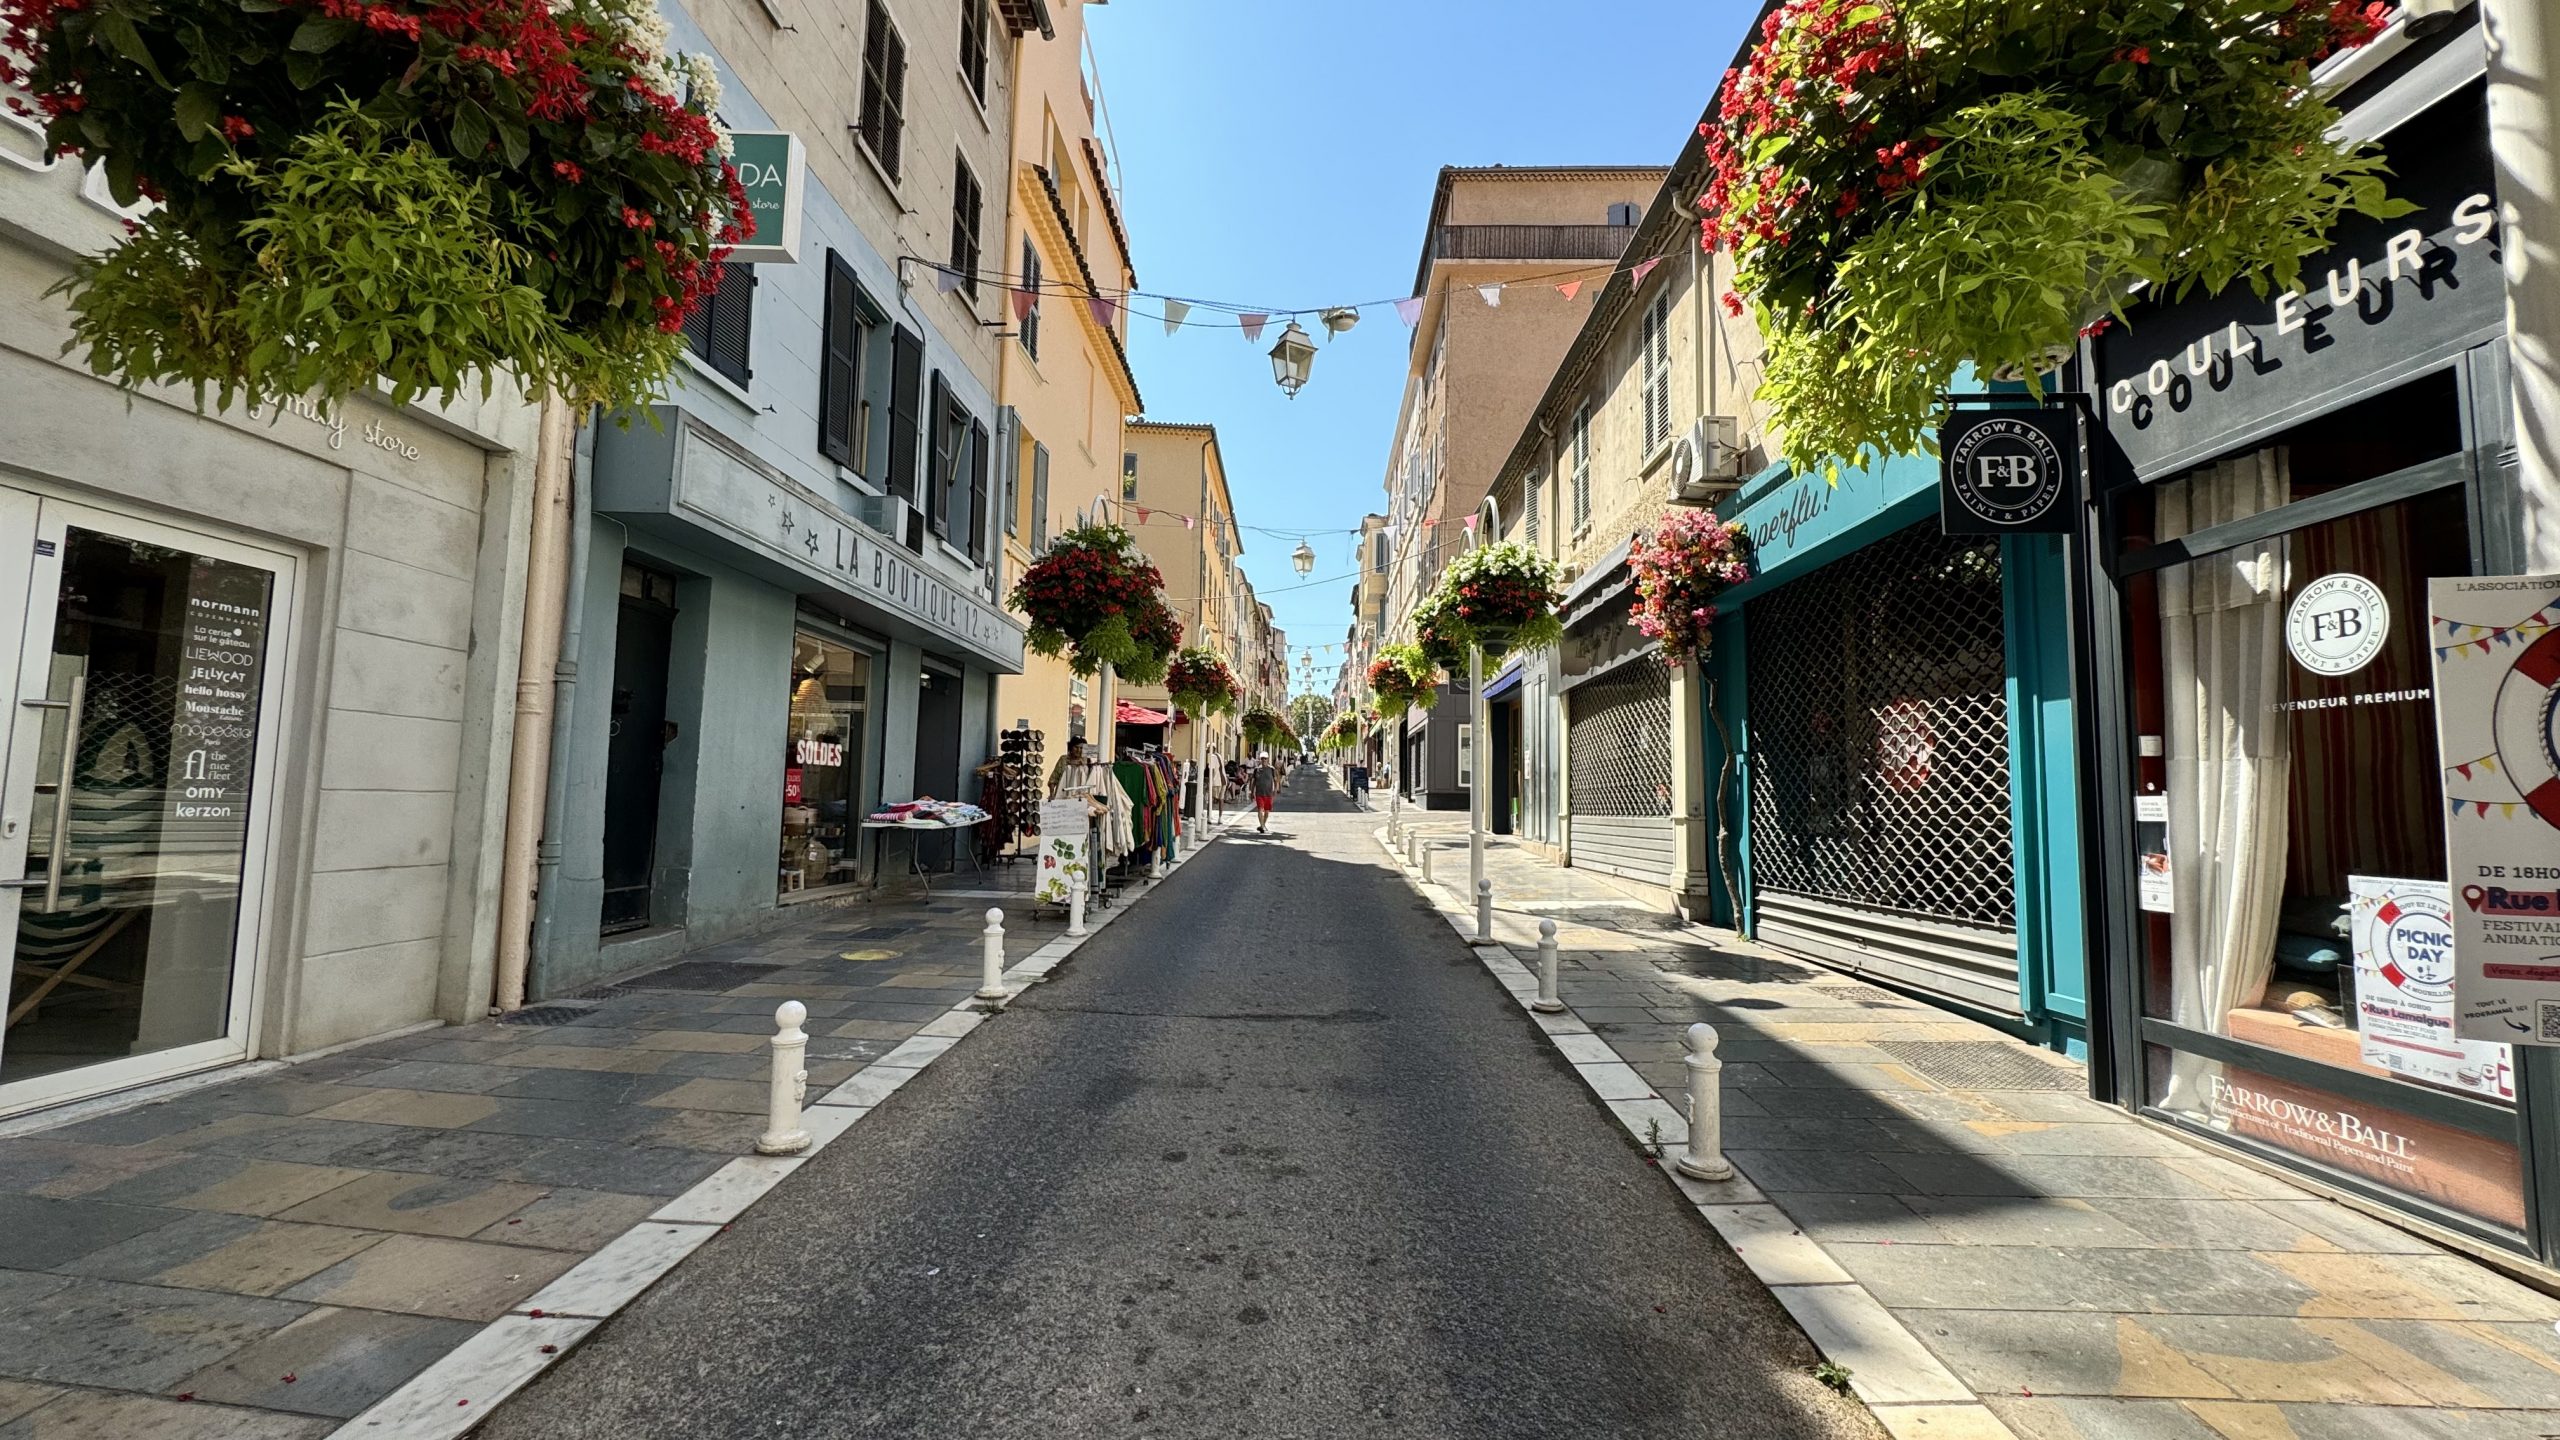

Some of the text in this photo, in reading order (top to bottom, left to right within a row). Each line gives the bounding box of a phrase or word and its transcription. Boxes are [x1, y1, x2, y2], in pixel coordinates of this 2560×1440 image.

[2112, 194, 2496, 413] COULEURS
[365, 419, 420, 460] store
[1956, 422, 2055, 464] FARROW & BALL
[1976, 455, 2037, 488] F&B
[1959, 483, 2056, 520] PAINT & PAPER
[836, 528, 978, 638] LA BOUTIQUE 12
[191, 597, 260, 617] normann
[2293, 580, 2379, 624] FARROW & BALL
[194, 625, 232, 638] La cerise
[2310, 606, 2362, 643] F&B
[209, 635, 218, 643] le
[2296, 641, 2327, 668] PAINT
[2348, 630, 2380, 664] PAPER
[186, 646, 254, 667] LIEWOOD
[184, 684, 248, 700] hello hossy
[2354, 688, 2430, 705] PREMIUM
[185, 701, 245, 716] Moustache
[211, 751, 228, 761] the
[796, 740, 842, 767] SOLDES
[210, 762, 231, 771] nice
[176, 802, 231, 818] kerzon
[2478, 865, 2506, 878] DE
[2487, 886, 2550, 911] Rue
[2396, 928, 2453, 948] PICNIC
[2408, 946, 2444, 963] DAY
[2369, 1003, 2389, 1016] Rue
[2282, 1122, 2331, 1147] Traditional
[2332, 1138, 2365, 1157] Papers
[2364, 1152, 2385, 1165] and
[2385, 1156, 2416, 1175] Paint
